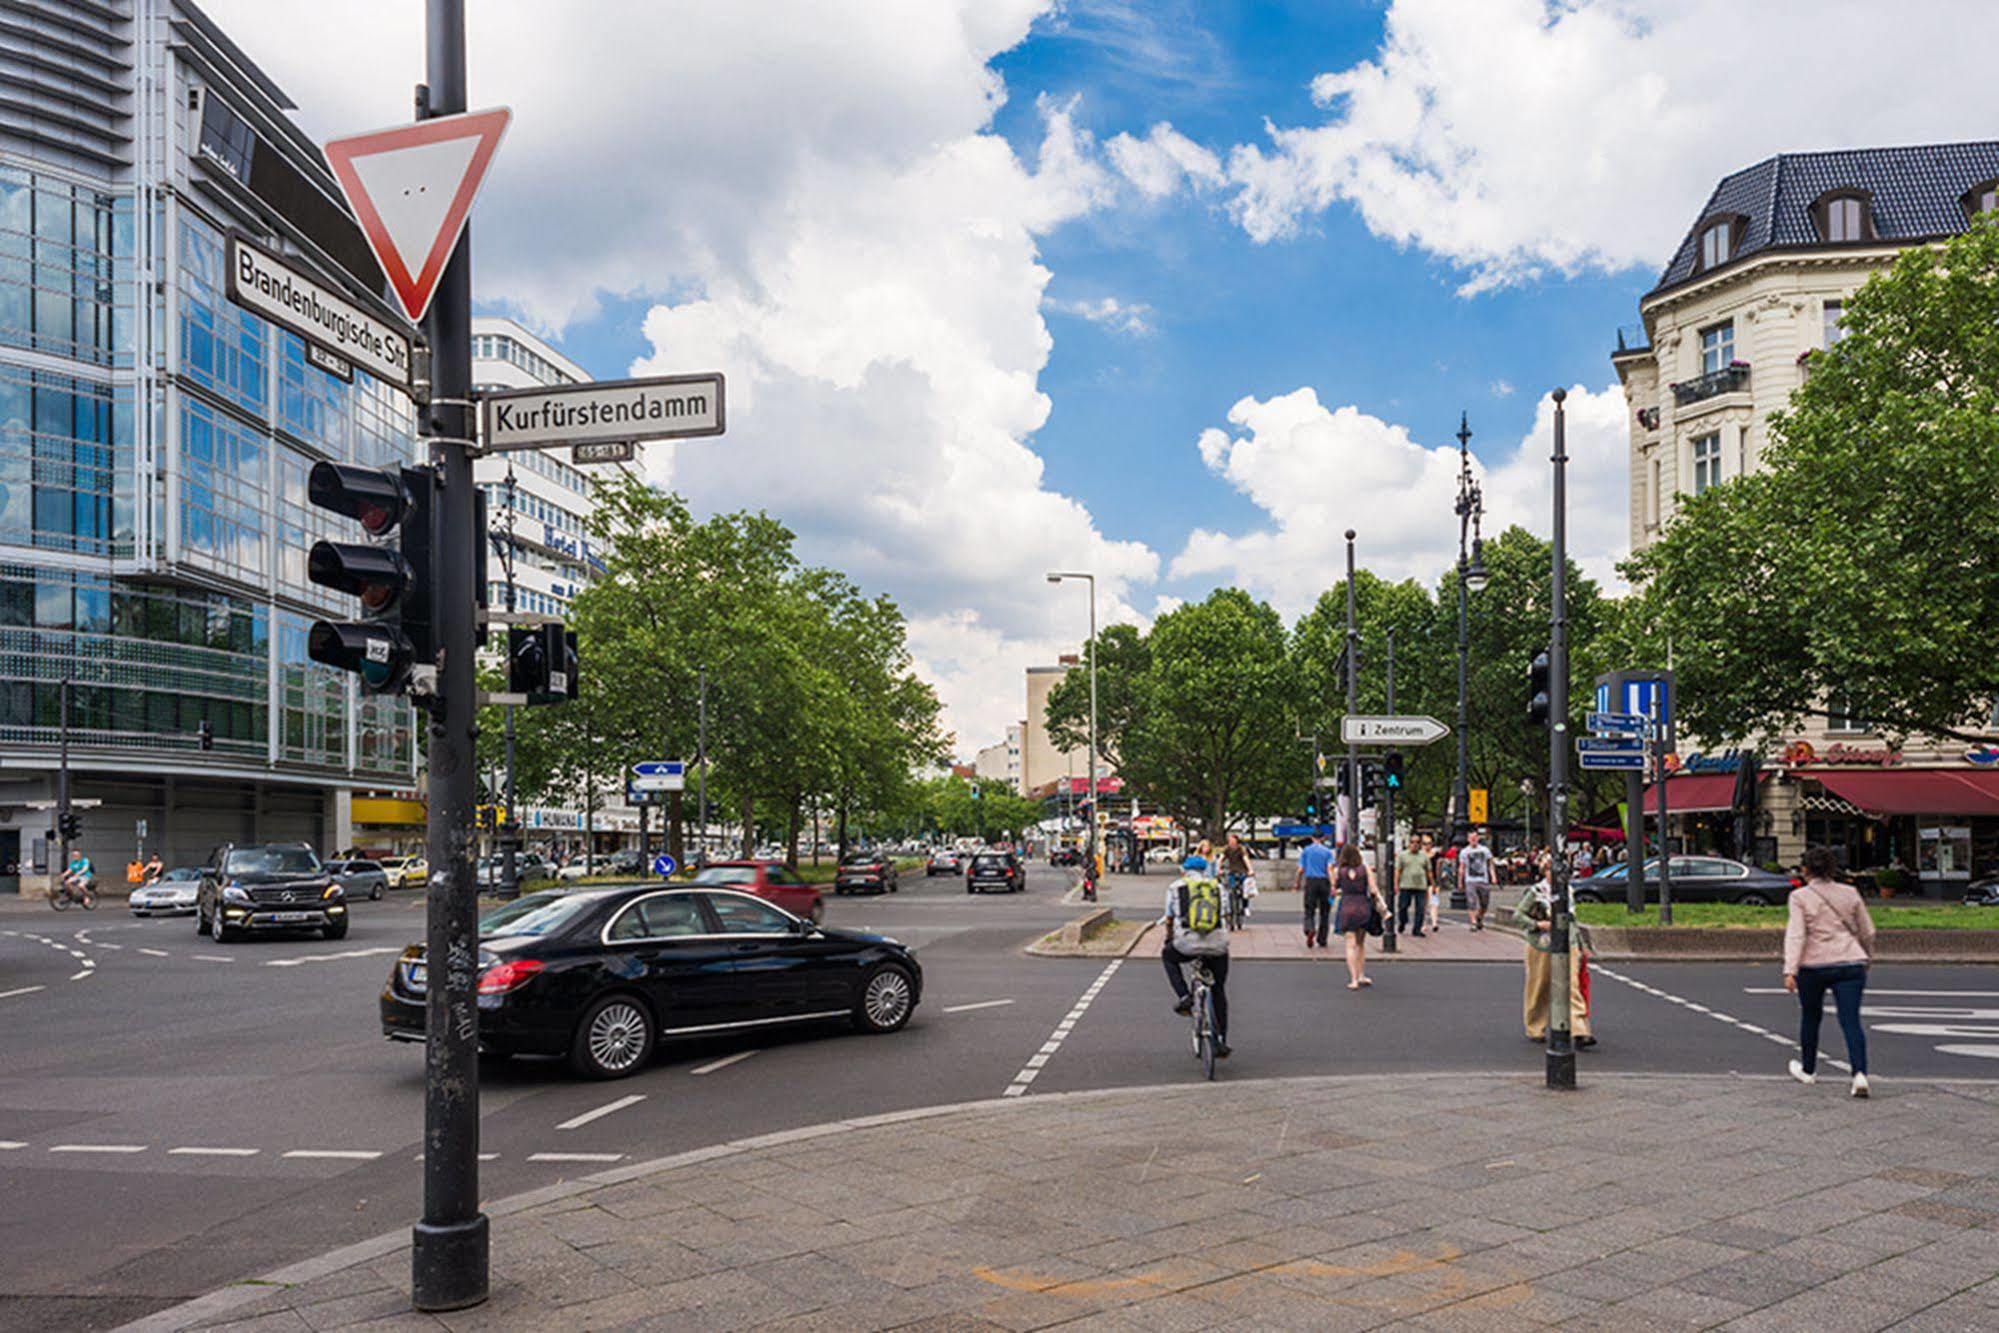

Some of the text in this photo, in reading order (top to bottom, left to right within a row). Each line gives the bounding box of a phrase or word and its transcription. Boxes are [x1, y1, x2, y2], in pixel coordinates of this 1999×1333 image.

[239, 250, 382, 357] Brandenburgische
[496, 394, 707, 432] Kurfürstendamm
[1374, 723, 1424, 736] Zentrum
